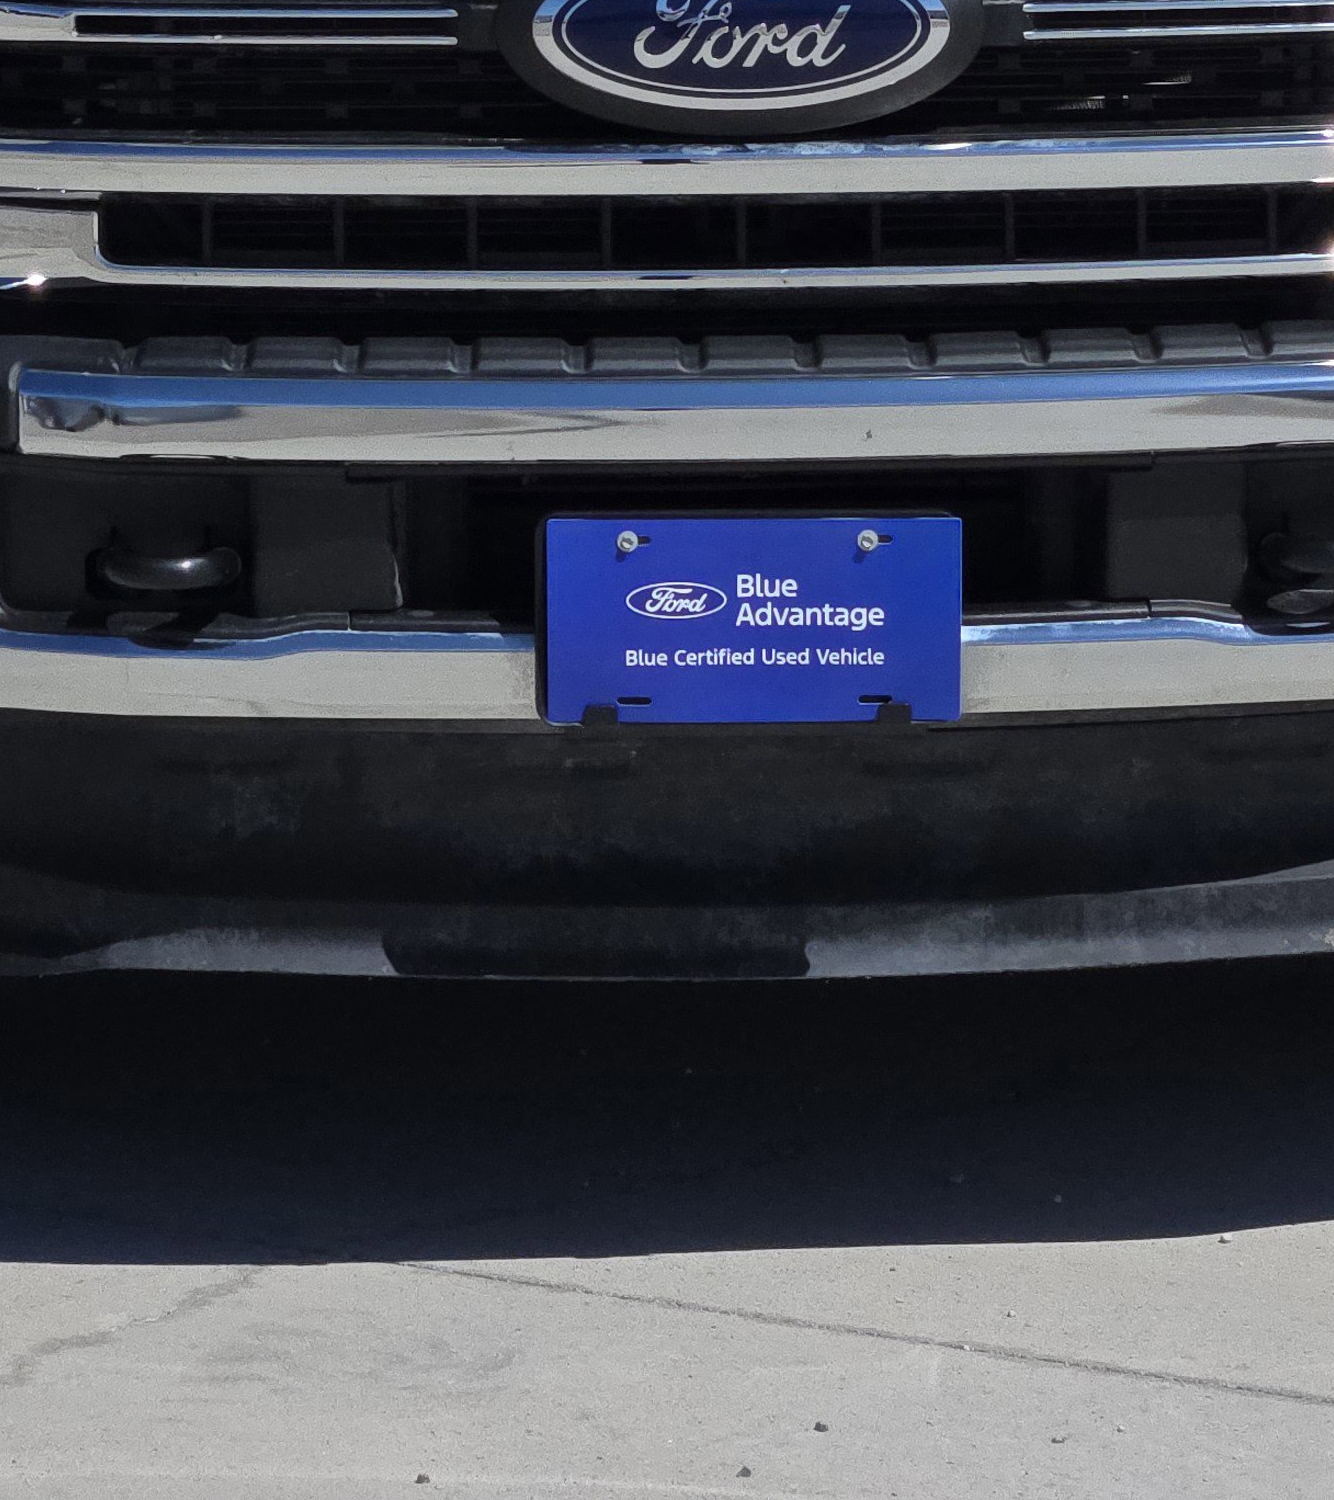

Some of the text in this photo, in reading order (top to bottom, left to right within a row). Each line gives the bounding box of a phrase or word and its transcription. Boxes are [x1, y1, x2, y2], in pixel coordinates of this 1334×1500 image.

[736, 574, 798, 599] Blue
[645, 587, 707, 615] Ford
[736, 602, 885, 632] Advantage
[625, 647, 885, 667] Blue Certified Used Vehicle
